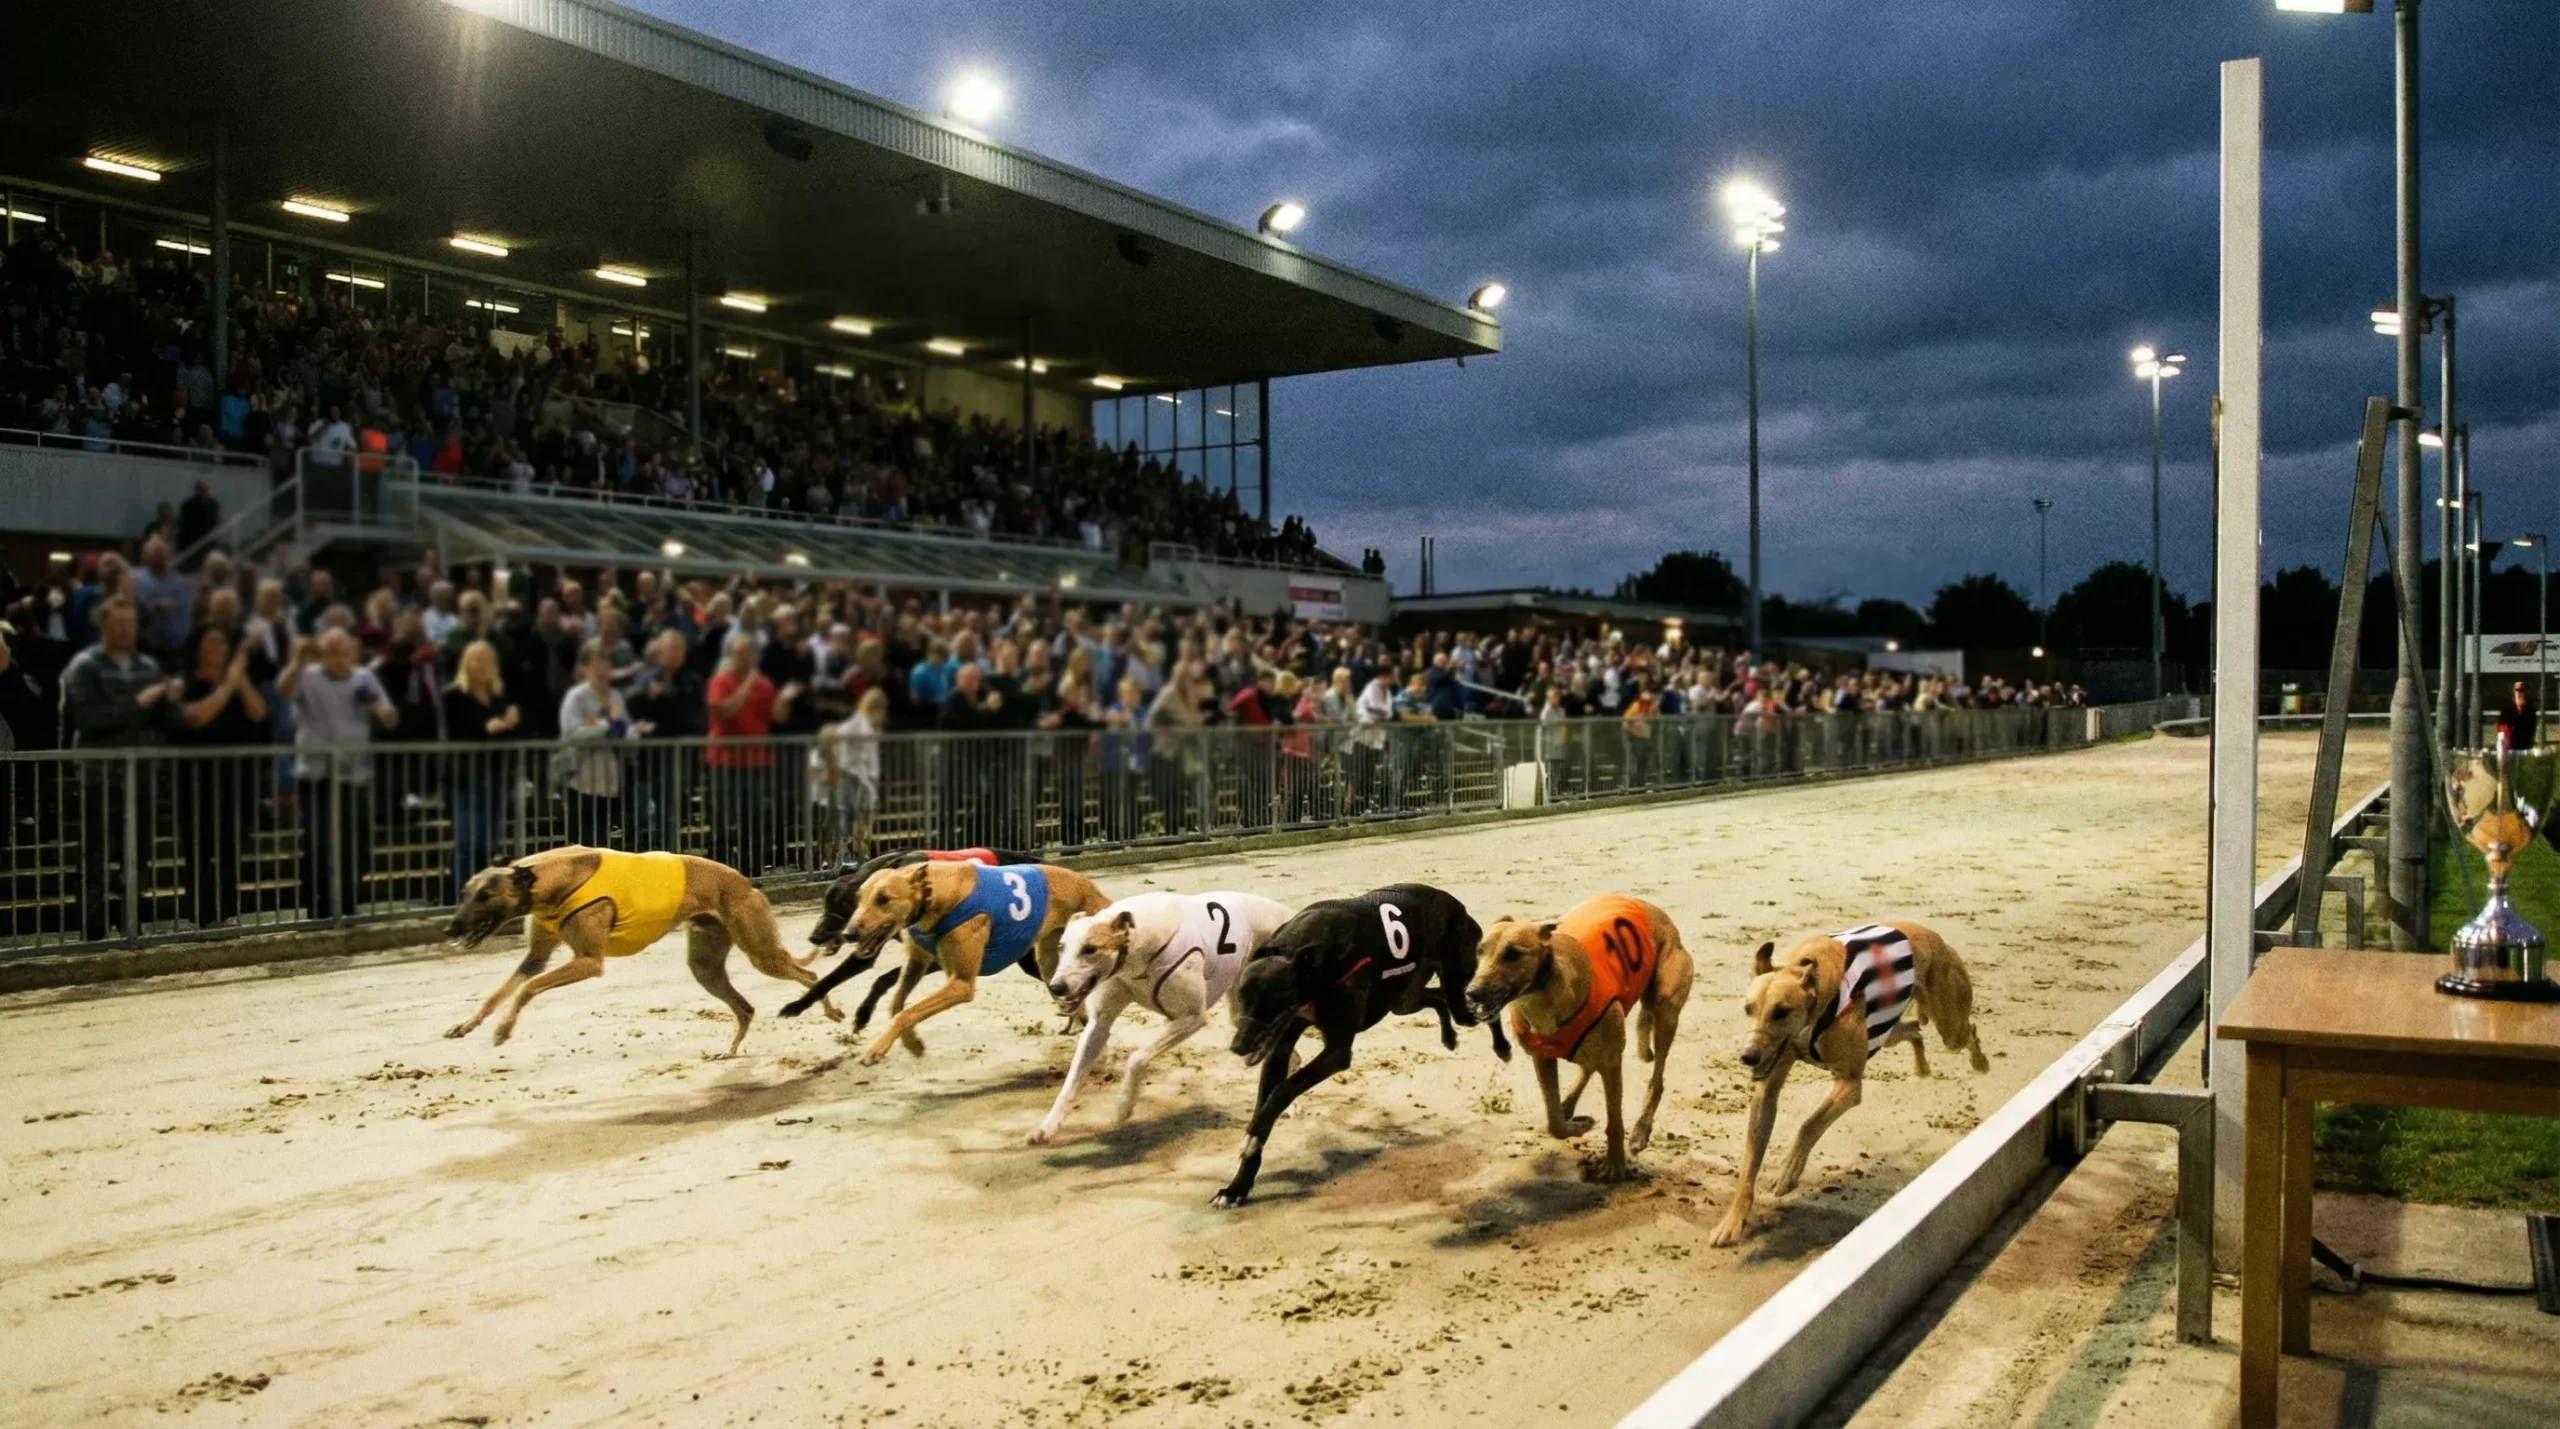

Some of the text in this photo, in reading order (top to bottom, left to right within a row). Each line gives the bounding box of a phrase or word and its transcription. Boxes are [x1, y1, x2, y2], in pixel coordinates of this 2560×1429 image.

[1003, 871, 1032, 921] 3
[1206, 901, 1237, 955] 2
[1379, 903, 1410, 959] 6
